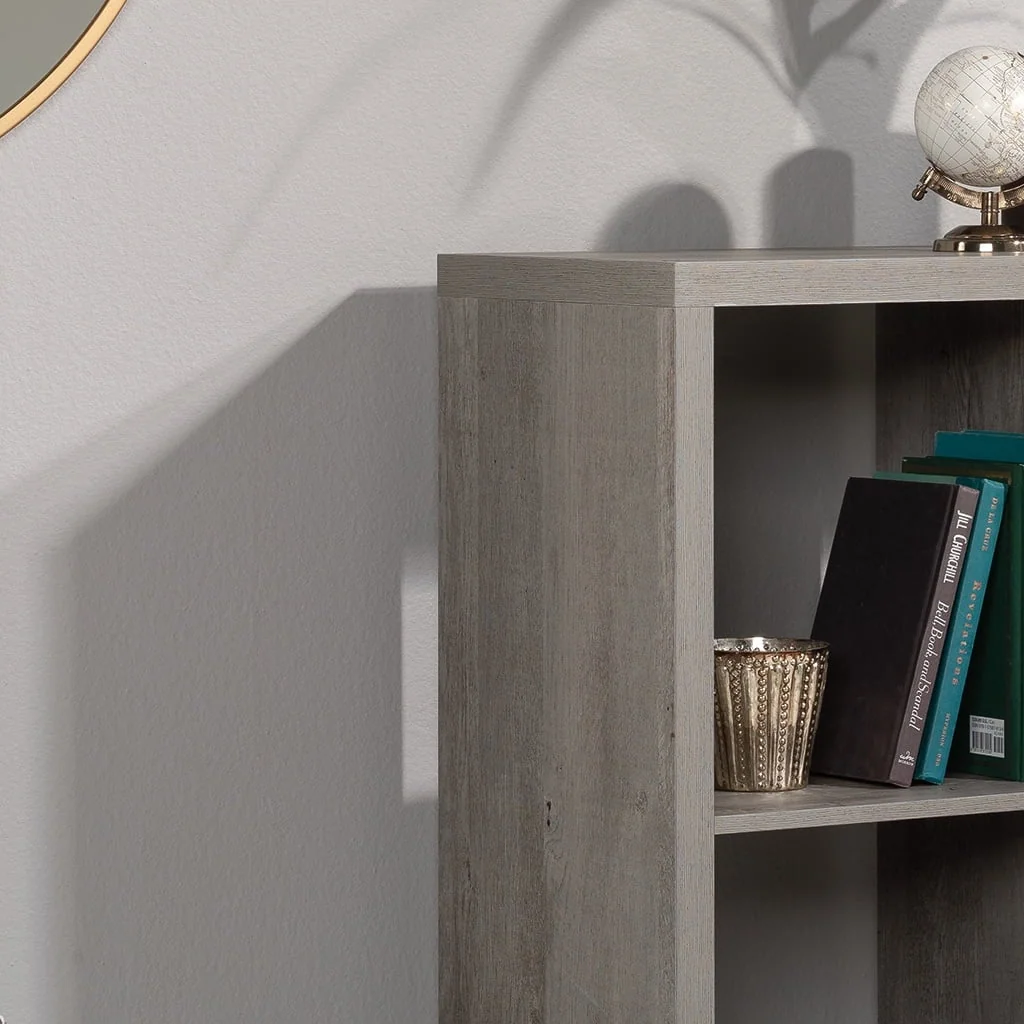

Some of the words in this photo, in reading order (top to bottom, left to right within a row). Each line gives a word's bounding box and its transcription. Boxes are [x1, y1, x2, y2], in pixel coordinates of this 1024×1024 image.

[955, 509, 974, 529] JILL
[980, 526, 993, 553] CRUZ
[942, 534, 967, 584] CHURCHILL
[931, 600, 949, 626] Bell,
[924, 626, 942, 658] Book,
[952, 579, 982, 688] Revelations
[918, 660, 933, 681] and
[908, 681, 928, 731] Scandal
